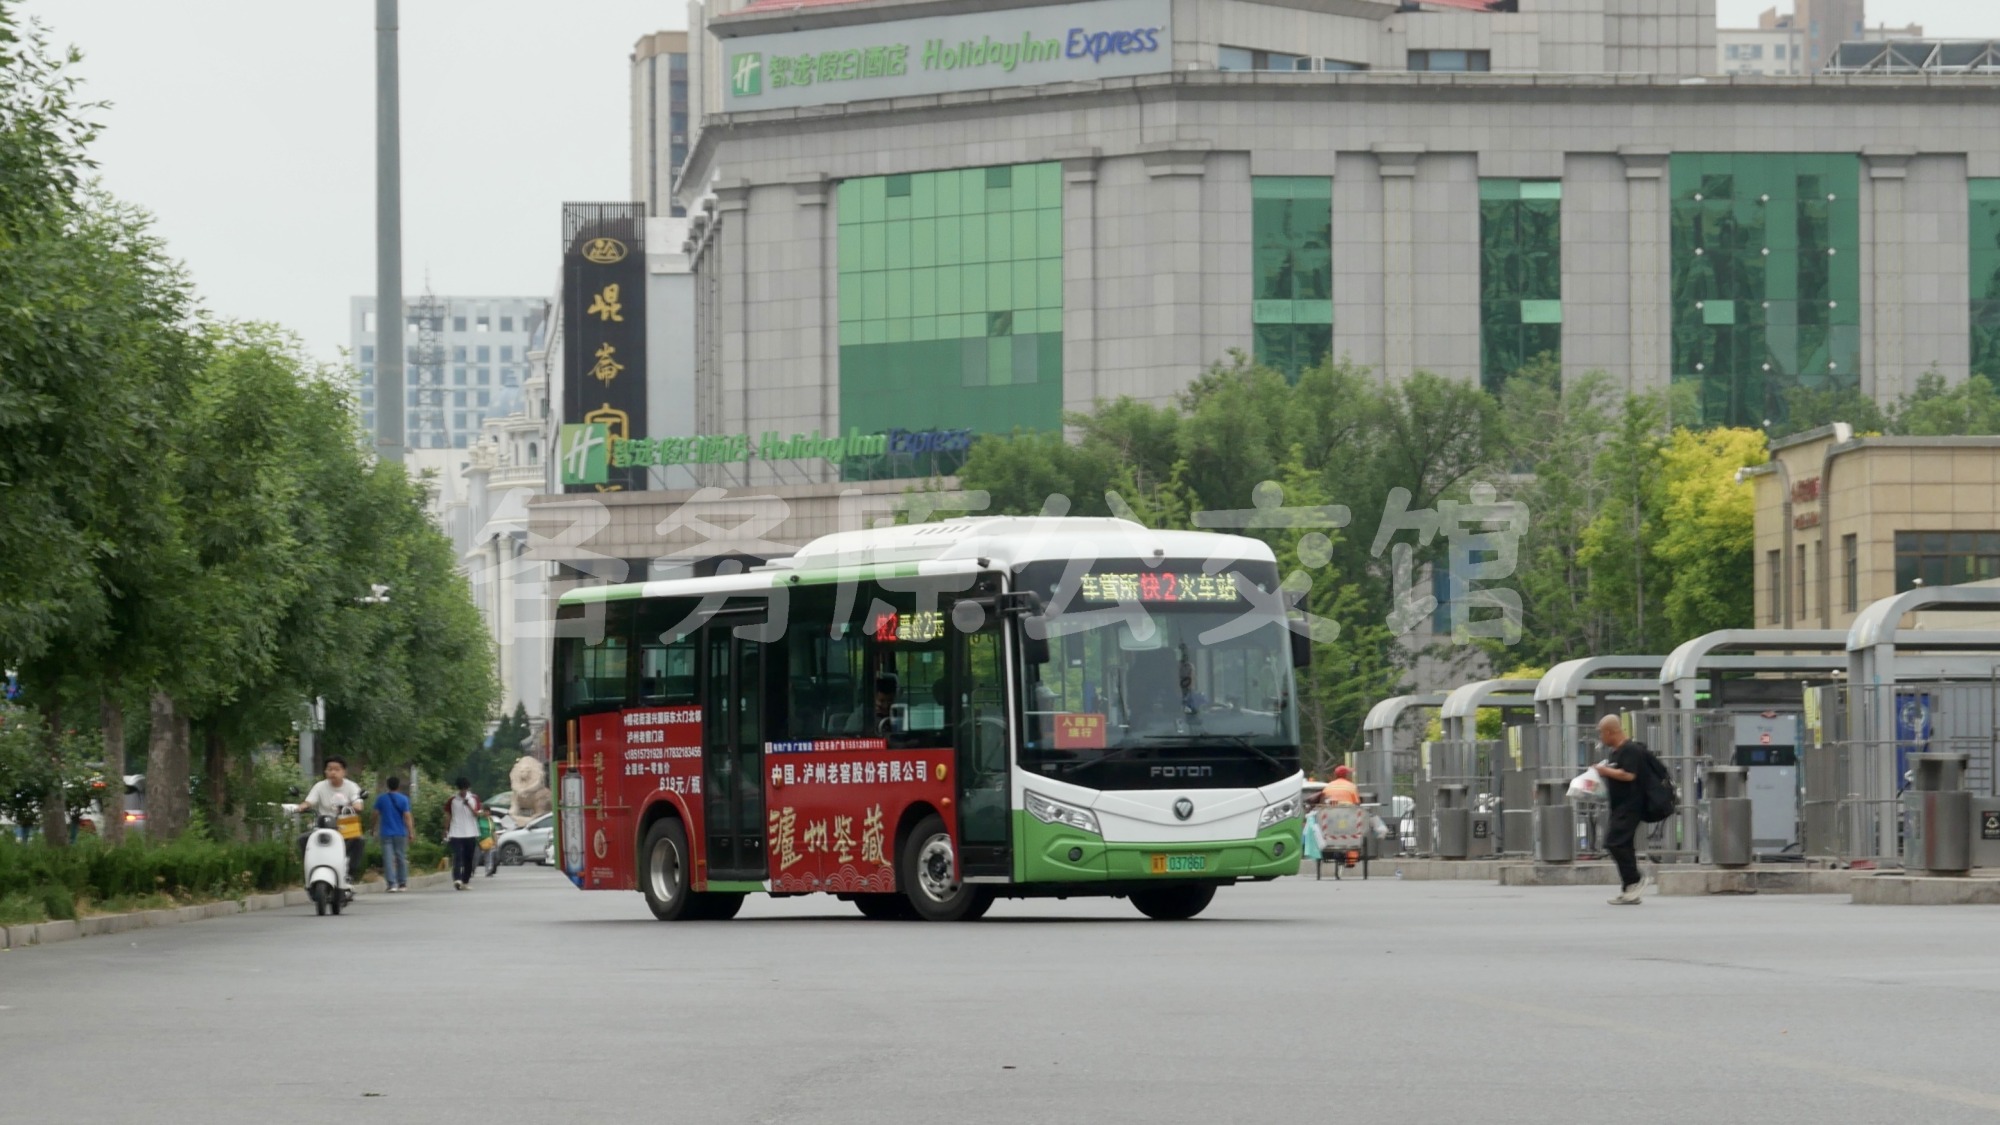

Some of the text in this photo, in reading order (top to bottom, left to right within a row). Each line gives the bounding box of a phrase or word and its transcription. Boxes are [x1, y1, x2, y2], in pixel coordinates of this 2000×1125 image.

[1065, 27, 1158, 63] Express
[1080, 572, 1238, 600] 车管所快2火车站
[1150, 766, 1213, 778] FOTON
